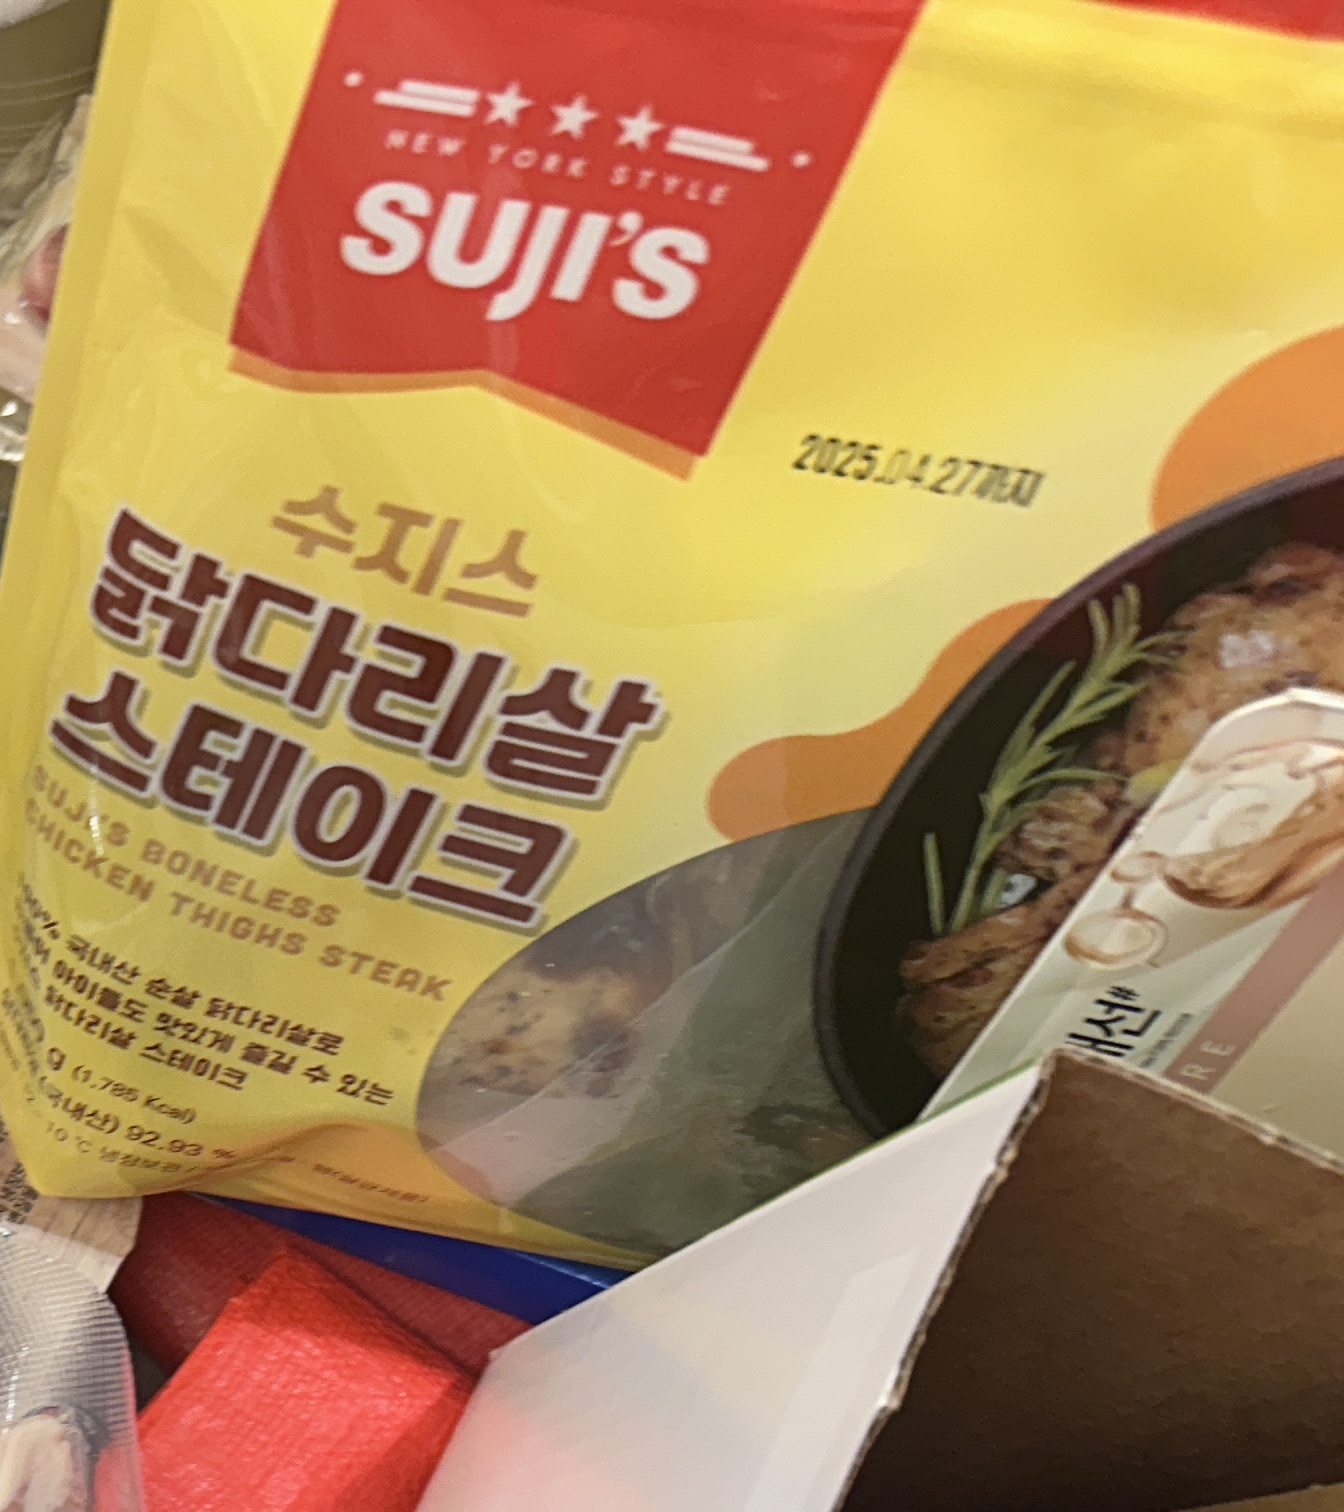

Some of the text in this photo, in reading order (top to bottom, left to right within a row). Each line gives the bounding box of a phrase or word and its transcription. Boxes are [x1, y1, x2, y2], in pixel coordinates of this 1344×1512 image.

[384, 129, 731, 205] NEW YORK STYLE
[340, 181, 710, 320] SUJI'S
[270, 484, 538, 618] 수지스
[90, 507, 663, 796] 닭다리살
[49, 670, 569, 926] 스테이크
[24, 798, 454, 1002] CHICKEN THIGHS STEAK
[140, 838, 341, 928] BONELESS
[44, 983, 139, 1051] 닭다리살
[139, 1041, 250, 1092] 스테이크
[52, 958, 396, 1107] 아이들도 맛있게 즐길 수 있는
[65, 934, 346, 1057] 국내산 순살 닭다리살로
[124, 1123, 203, 1160] 92.93
